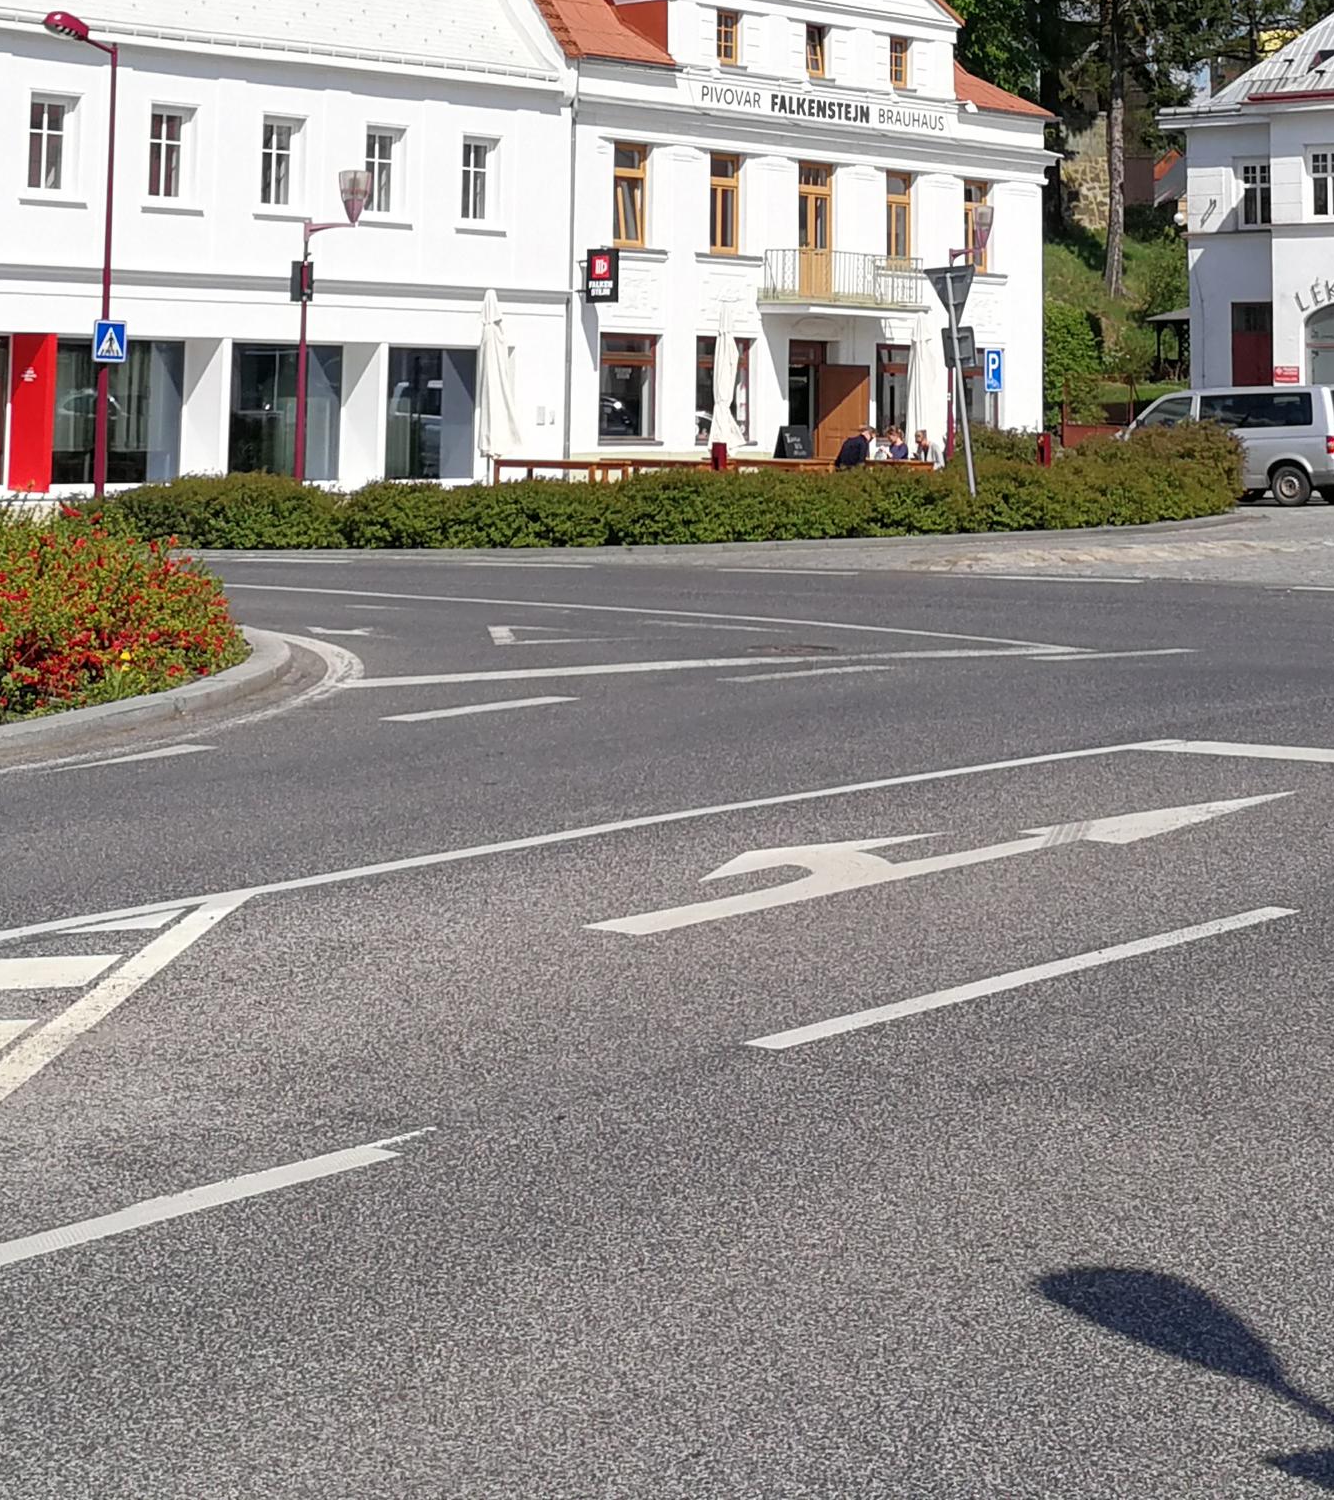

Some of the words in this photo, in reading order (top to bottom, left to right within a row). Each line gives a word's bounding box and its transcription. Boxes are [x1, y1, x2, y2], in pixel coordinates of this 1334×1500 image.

[701, 85, 761, 109] PIVOVAR
[770, 93, 870, 124] FALKENSTEJN
[878, 108, 944, 131] BRAUHAUS
